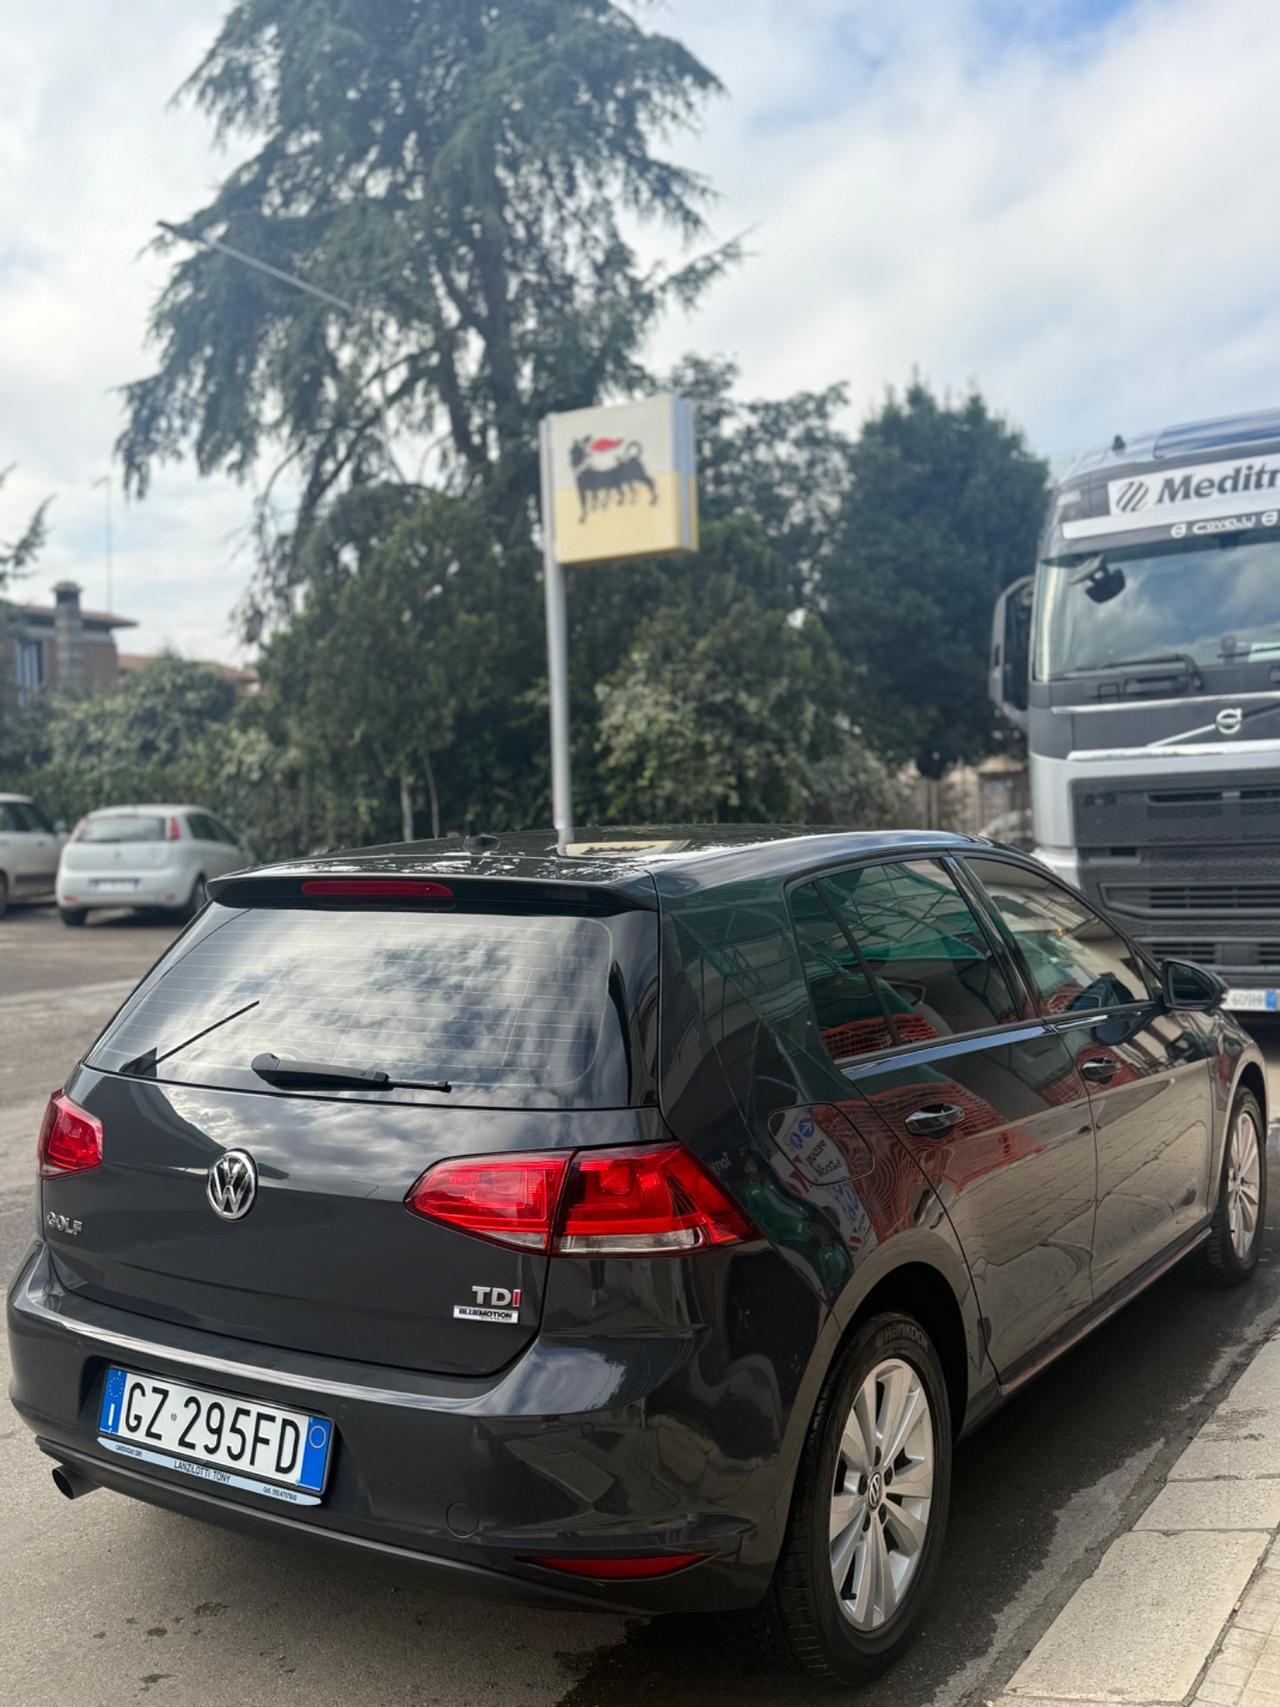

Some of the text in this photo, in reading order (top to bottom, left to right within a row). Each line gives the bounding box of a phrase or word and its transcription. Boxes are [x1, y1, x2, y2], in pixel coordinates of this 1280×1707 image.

[1156, 462, 1280, 505] Meditr
[208, 1151, 255, 1219] VW
[46, 1211, 82, 1235] GOLF
[472, 1286, 521, 1307] TDI
[459, 1308, 512, 1318] BLUEMOTION
[124, 1382, 169, 1441] GZ
[178, 1396, 300, 1474] 295FD
[173, 1460, 231, 1485] LANZILOTTI TONY
